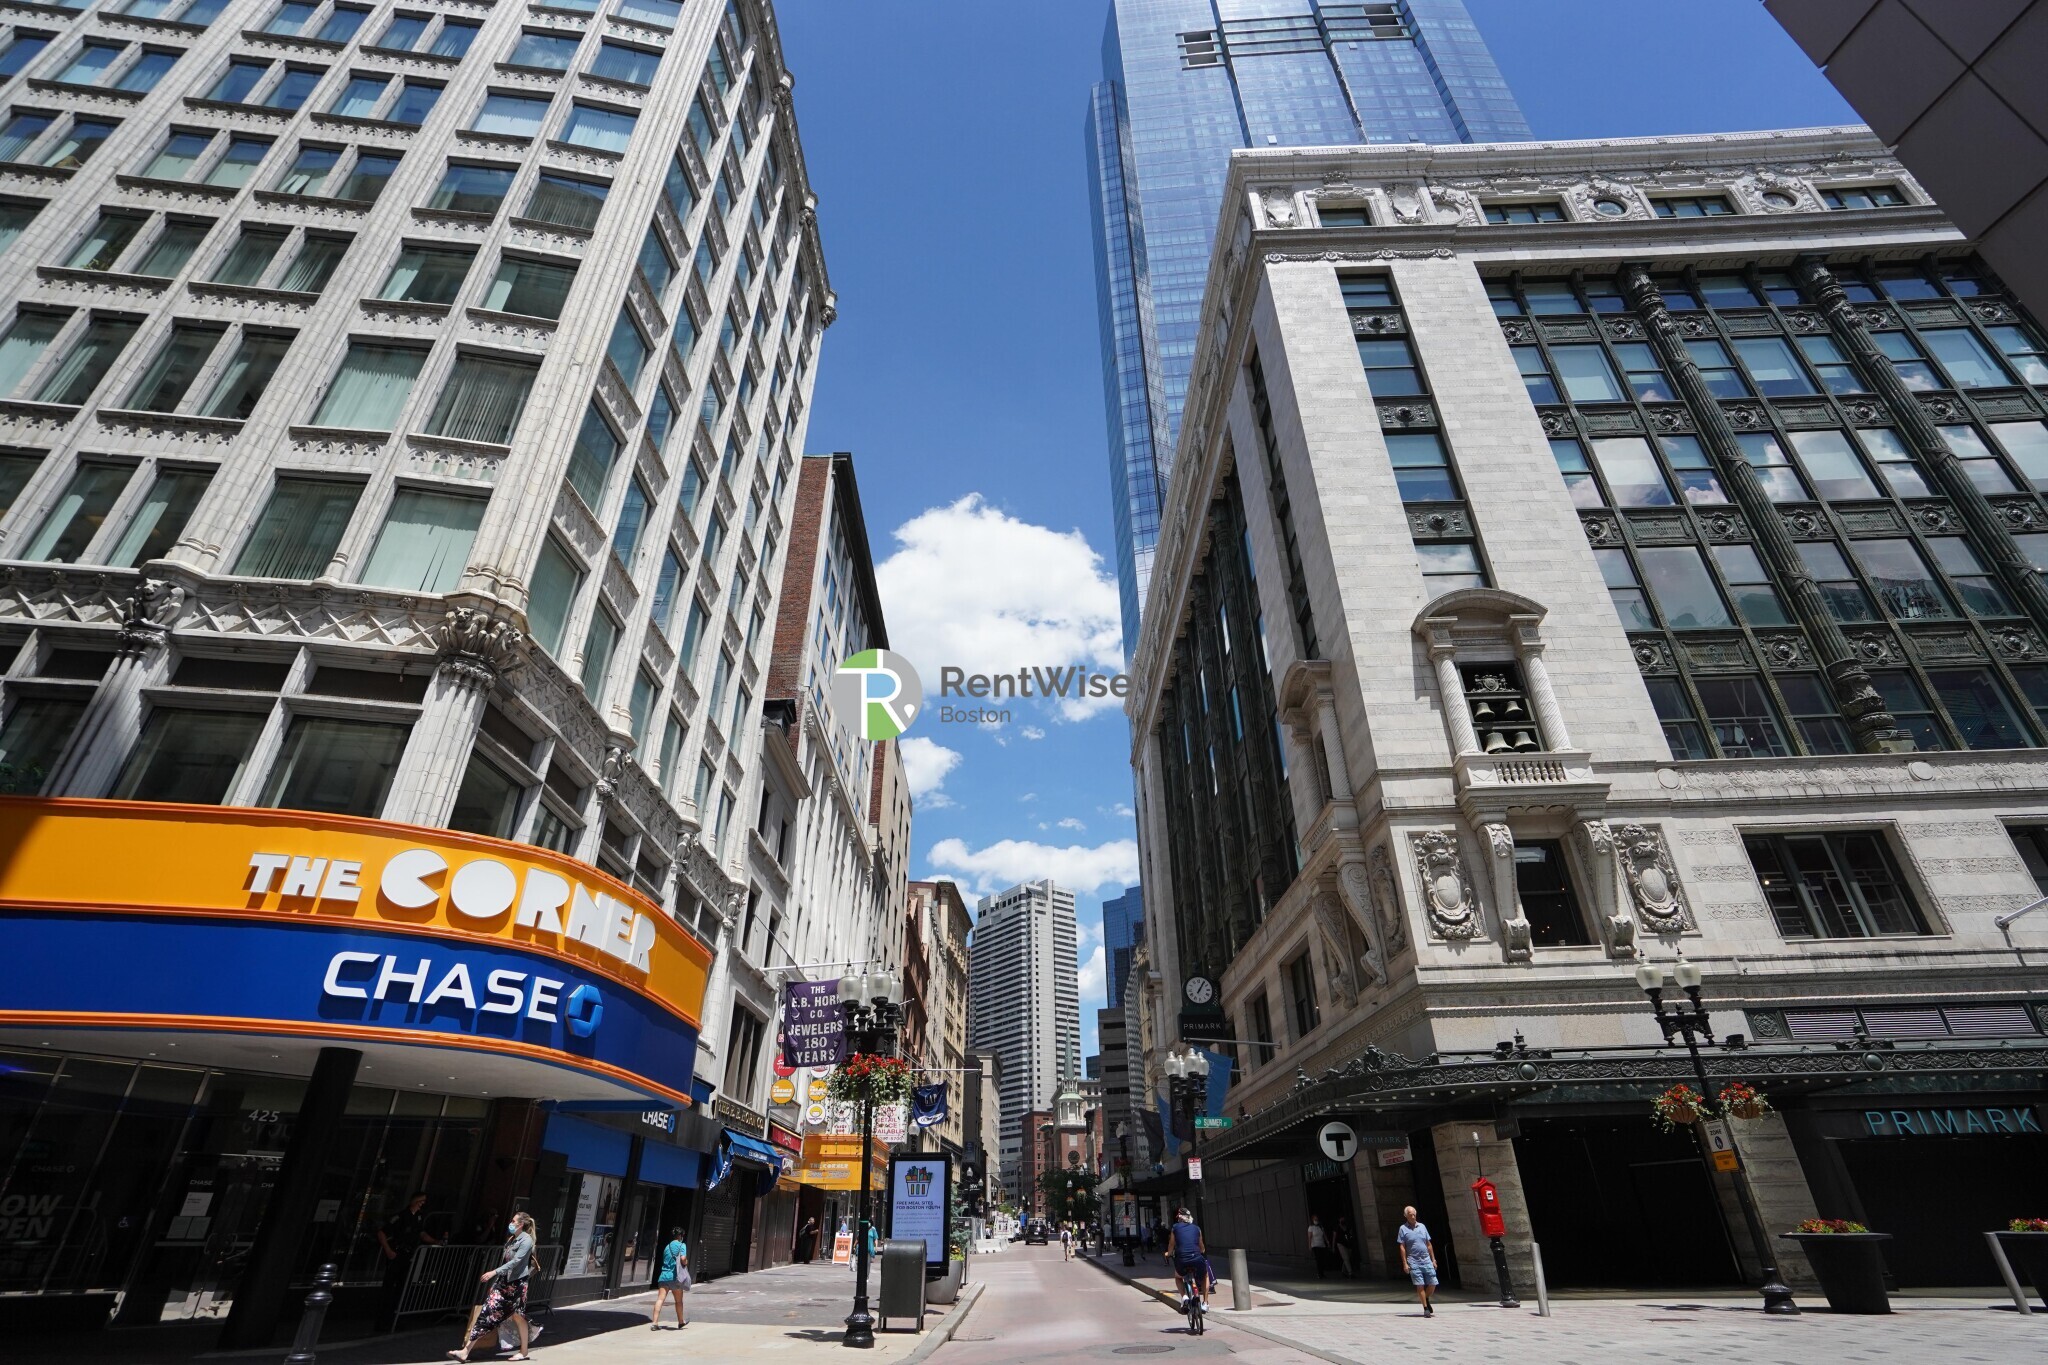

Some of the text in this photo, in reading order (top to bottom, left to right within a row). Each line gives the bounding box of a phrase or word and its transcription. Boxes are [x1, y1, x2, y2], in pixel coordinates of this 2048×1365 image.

[249, 848, 656, 974] THE CORNER
[323, 951, 565, 1023] CHASE
[810, 985, 826, 994] THE
[791, 997, 811, 1008] E.B.
[809, 1009, 825, 1019] CO.
[787, 1019, 843, 1036] JEWELERS
[1183, 1022, 1222, 1030] PRIMARK
[804, 1036, 828, 1049] 180
[796, 1049, 835, 1064] YEARS
[924, 1093, 938, 1105] GAP
[718, 1100, 729, 1115] THE
[248, 1109, 281, 1122] 425
[641, 1111, 669, 1130] CHASE
[1203, 1117, 1223, 1127] SUMMER
[1865, 1107, 2044, 1136] PRIMARK
[1709, 1128, 1722, 1136] ZONE
[1325, 1132, 1352, 1157] T
[1362, 1136, 1401, 1144] PRIMARK
[1304, 1160, 1339, 1181] PRIMARK
